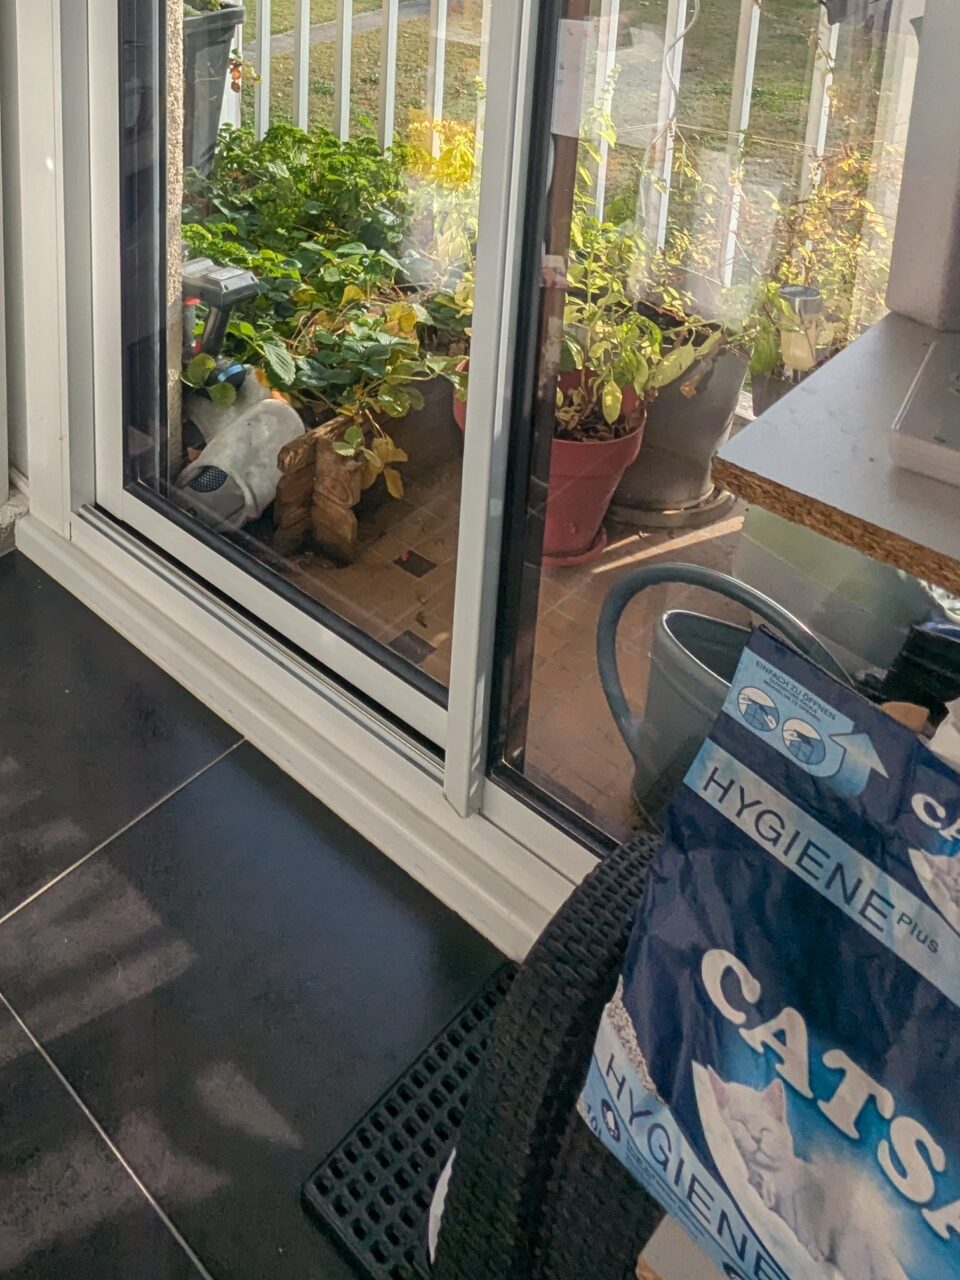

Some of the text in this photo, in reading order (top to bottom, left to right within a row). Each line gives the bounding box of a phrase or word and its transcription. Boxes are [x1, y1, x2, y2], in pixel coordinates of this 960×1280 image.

[755, 660, 790, 687] EINFACH
[790, 683, 802, 696] ZU
[802, 692, 837, 721] ÖFFNEN
[702, 766, 896, 933] HYGIENE
[896, 911, 940, 954] Plus
